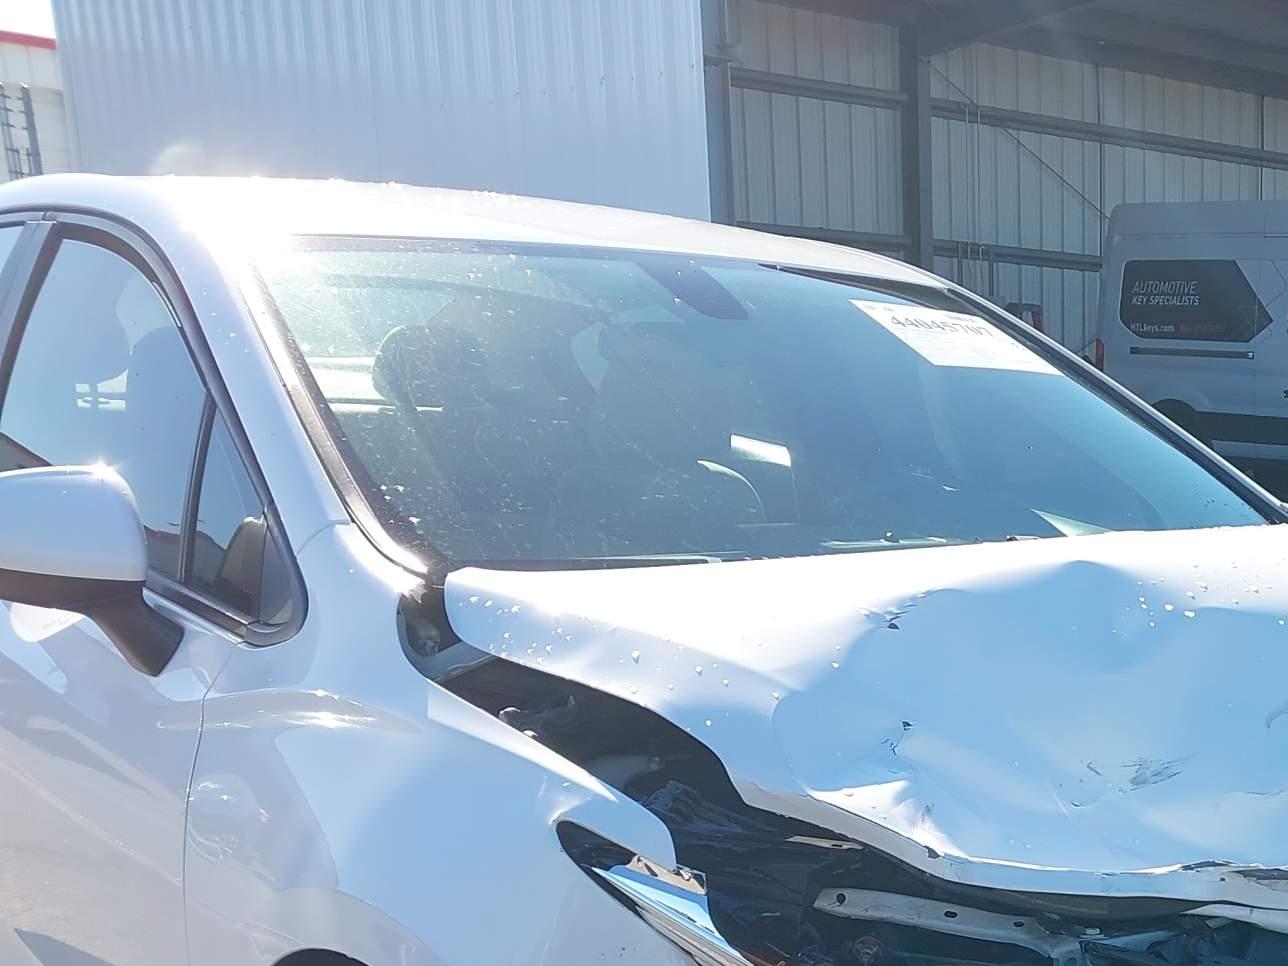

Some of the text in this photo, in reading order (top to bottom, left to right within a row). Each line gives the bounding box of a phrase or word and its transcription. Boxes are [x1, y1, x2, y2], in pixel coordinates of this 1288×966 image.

[1132, 280, 1199, 294] AUTOMOTIVE
[1132, 296, 1200, 306] KEY SPECIALISTS
[890, 315, 994, 338] 44045707
[1130, 323, 1175, 334] HTLkeys.com
